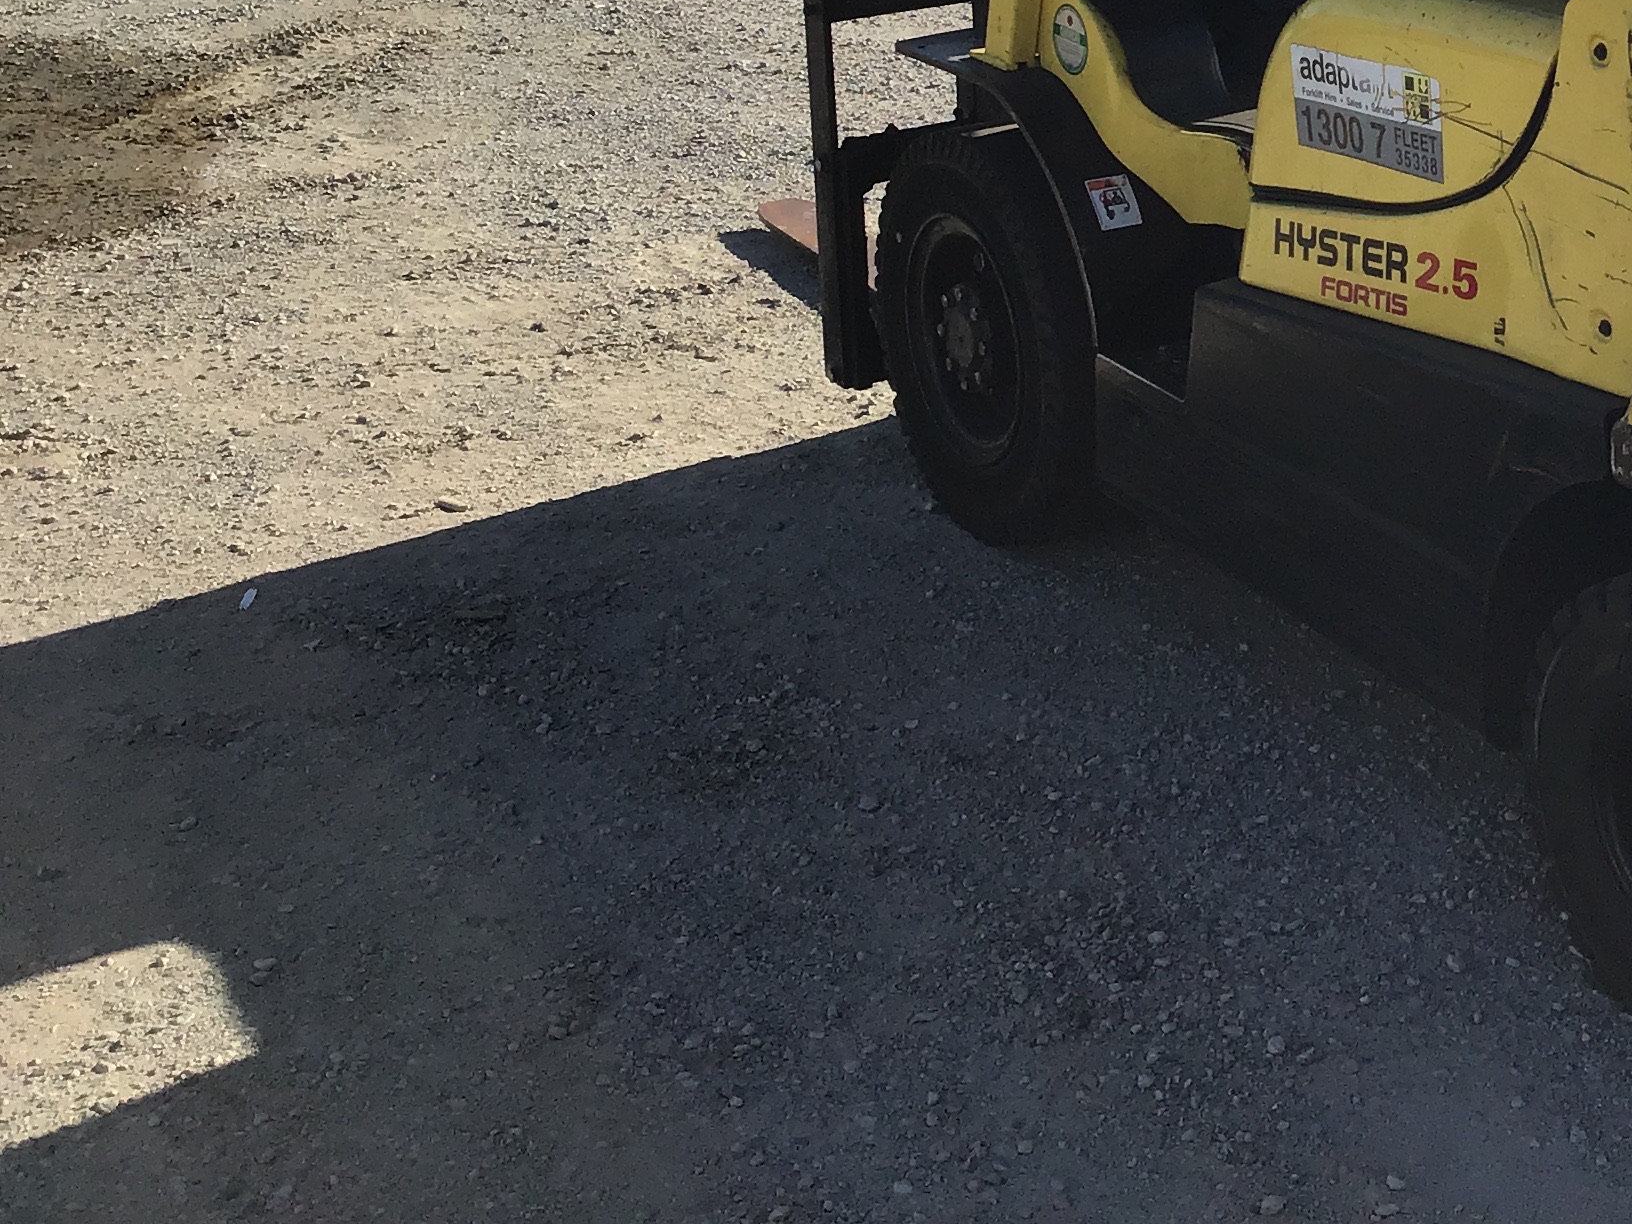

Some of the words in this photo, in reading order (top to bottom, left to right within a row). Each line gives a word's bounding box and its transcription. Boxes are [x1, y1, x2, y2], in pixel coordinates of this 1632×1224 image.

[1325, 89, 1337, 104] Hire
[1301, 105, 1364, 154] 1300
[1369, 121, 1387, 159] 7
[1394, 126, 1437, 155] FLEET
[1395, 147, 1438, 177] 35338
[1274, 217, 1409, 284] HYSTER
[1415, 251, 1479, 301] 2.5
[1320, 275, 1409, 317] FORTIS
